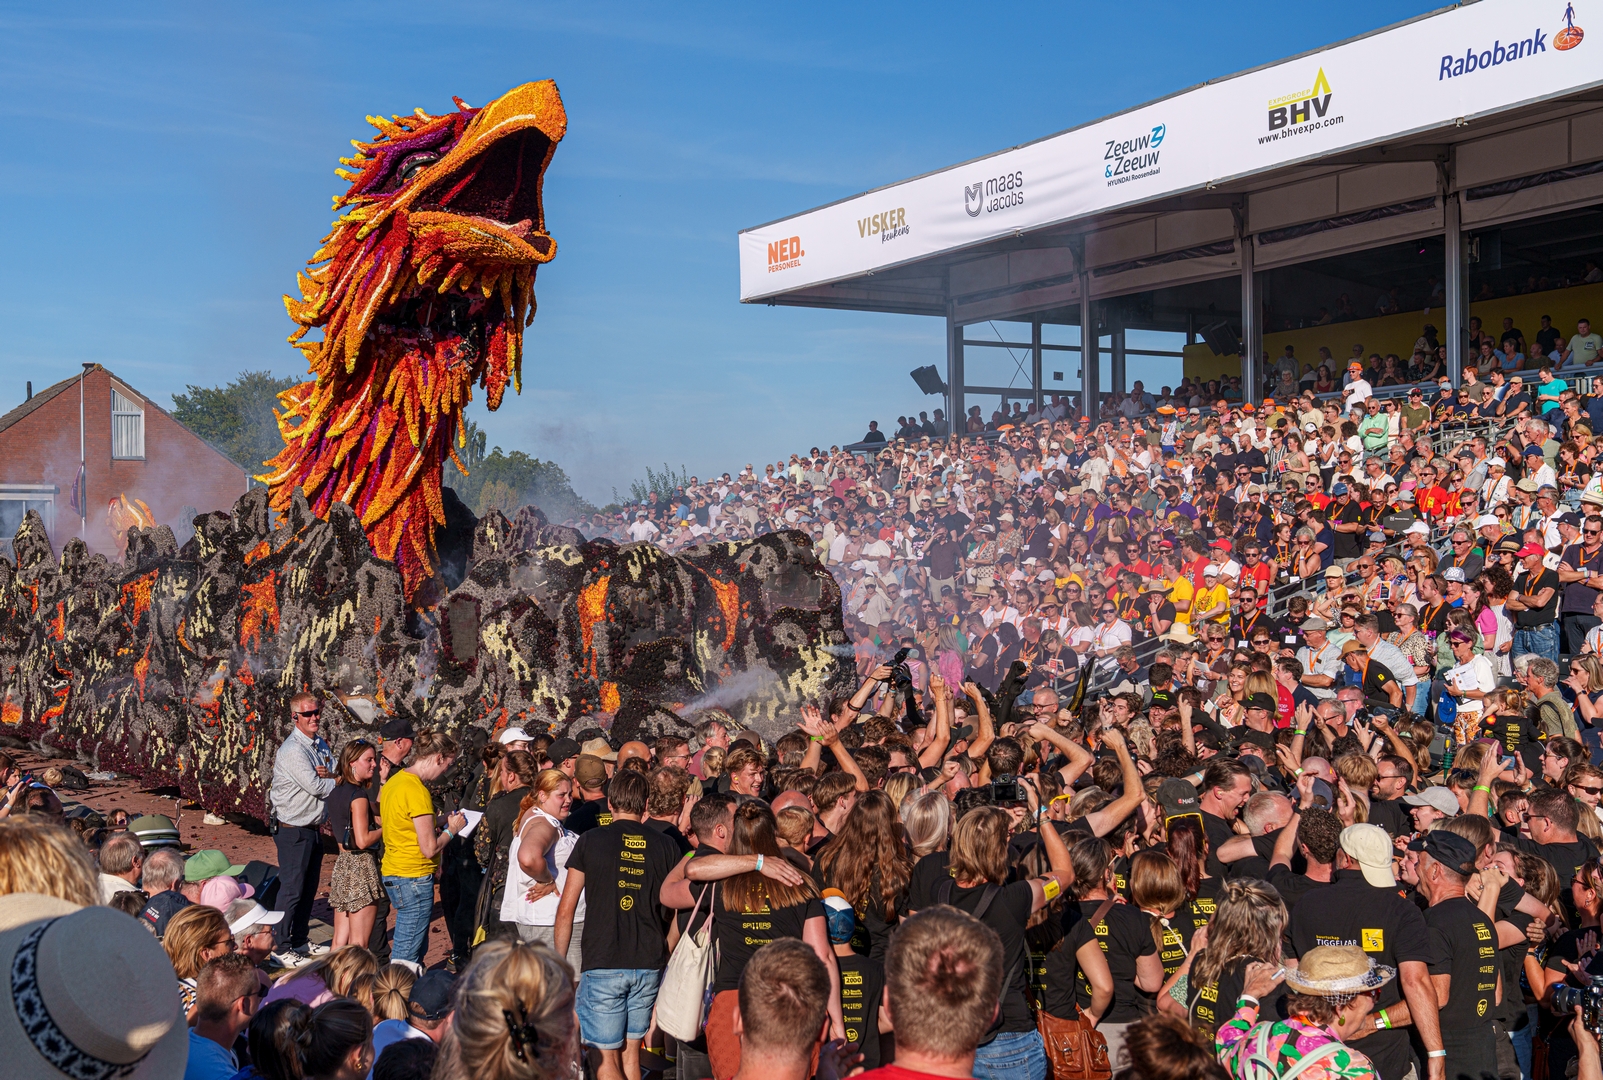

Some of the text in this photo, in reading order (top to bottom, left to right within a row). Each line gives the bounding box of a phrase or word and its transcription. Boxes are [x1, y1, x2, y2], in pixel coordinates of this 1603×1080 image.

[1439, 28, 1547, 81] Rabobank
[1268, 89, 1311, 105] EXPOGROEP
[1268, 93, 1332, 131] BHV
[1258, 115, 1344, 145] www.bhvexpo.com
[1104, 134, 1150, 160] Zeeuw
[1105, 151, 1160, 178] & Zeeuw
[1107, 167, 1161, 187] HYUNDAI Roosendaal
[986, 171, 1023, 196] maas
[857, 207, 906, 238] VISKER
[881, 223, 910, 244] keukens
[768, 236, 805, 265] NED.
[768, 260, 801, 273] PERSONEEL
